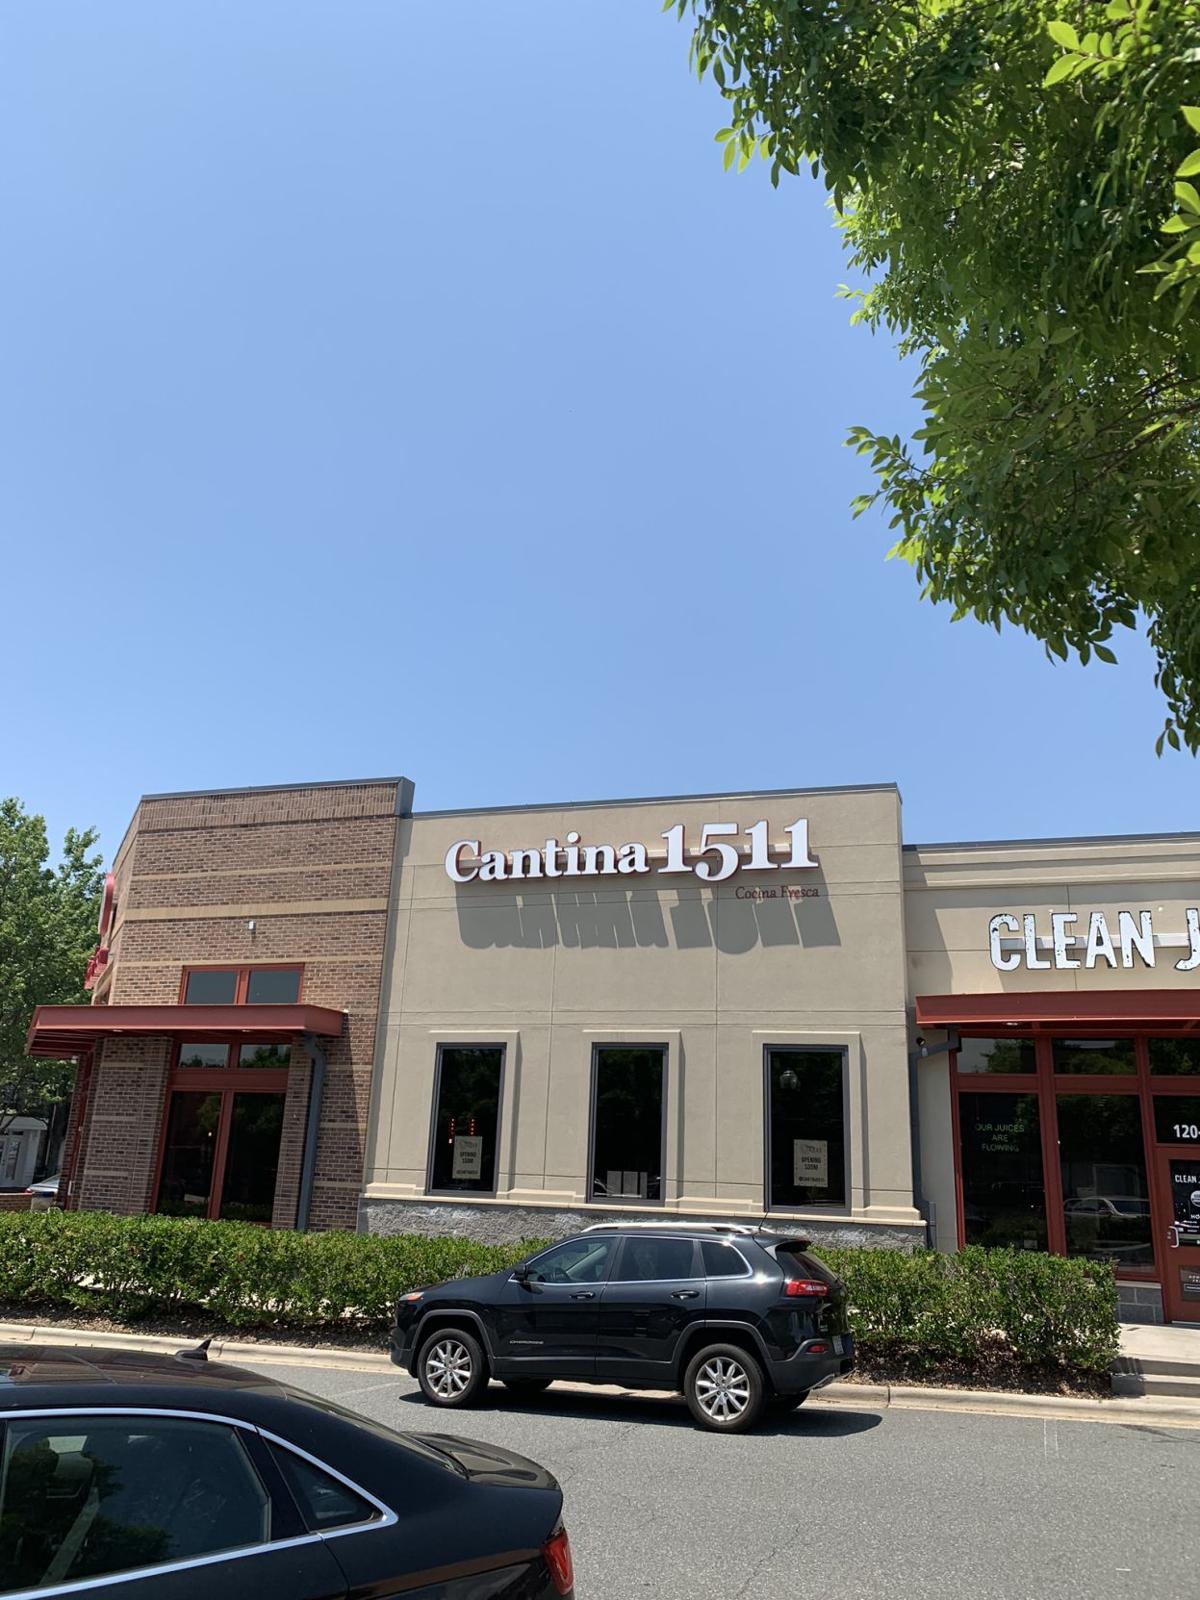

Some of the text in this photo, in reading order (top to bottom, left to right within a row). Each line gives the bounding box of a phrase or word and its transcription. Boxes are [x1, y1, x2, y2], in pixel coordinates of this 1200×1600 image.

[444, 818, 819, 883] Cantina 1511
[735, 885, 820, 899] Cocina Fresca
[988, 910, 1156, 971] CLEAN
[975, 1123, 1025, 1132] OUR JUICES
[992, 1134, 1009, 1142] ARE
[1174, 1174, 1197, 1183] CLEAN
